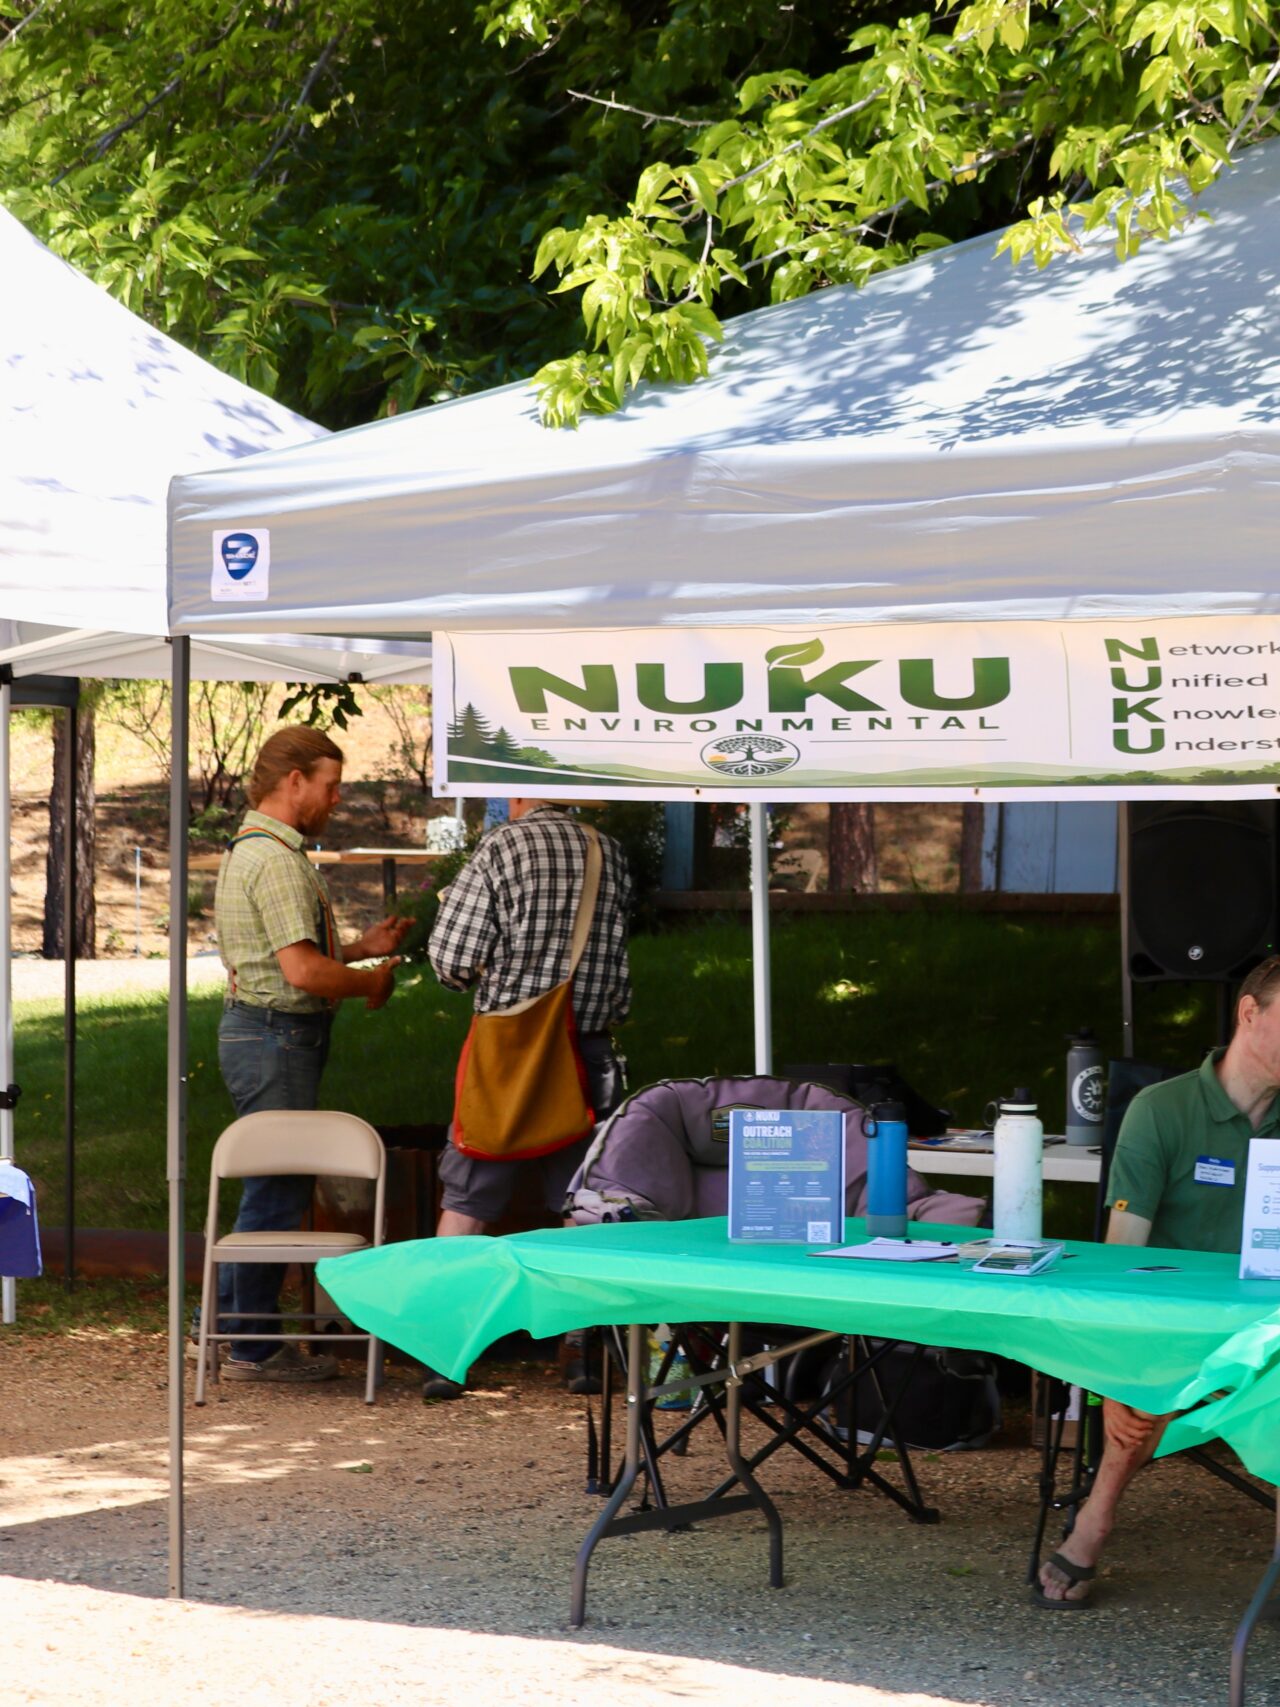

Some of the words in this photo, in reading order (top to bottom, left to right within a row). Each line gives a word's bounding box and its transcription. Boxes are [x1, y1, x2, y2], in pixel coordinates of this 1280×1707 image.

[508, 655, 1011, 715] NUKU
[531, 716, 1001, 733] ENVIRONMENTAL
[742, 1125, 793, 1137] OUTREACH
